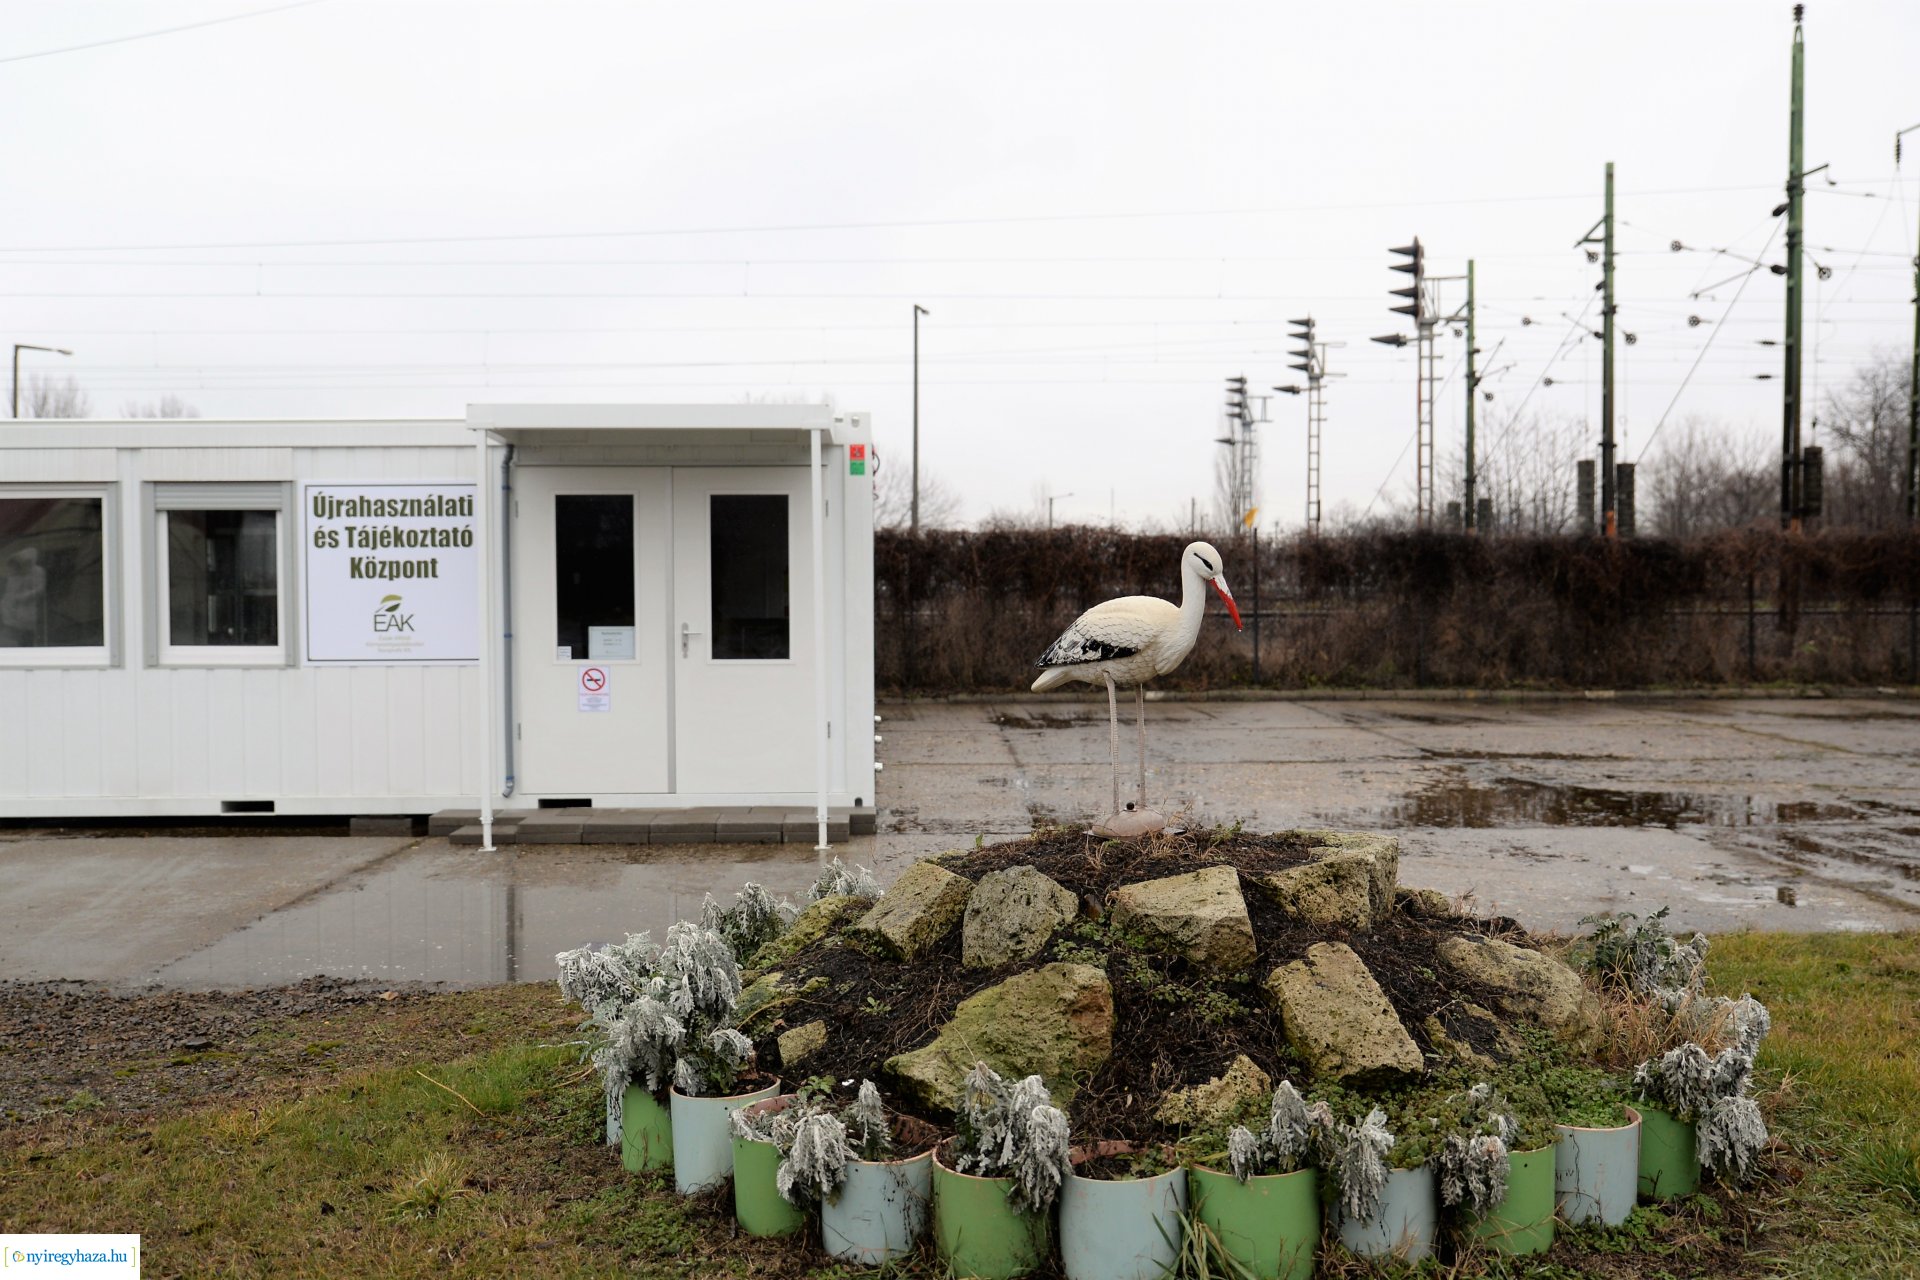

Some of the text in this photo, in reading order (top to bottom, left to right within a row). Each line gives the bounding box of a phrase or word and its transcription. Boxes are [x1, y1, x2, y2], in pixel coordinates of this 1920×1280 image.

[313, 491, 474, 520] Újrahasználati
[314, 524, 473, 550] és Tájékoztató
[350, 556, 439, 581] Központ
